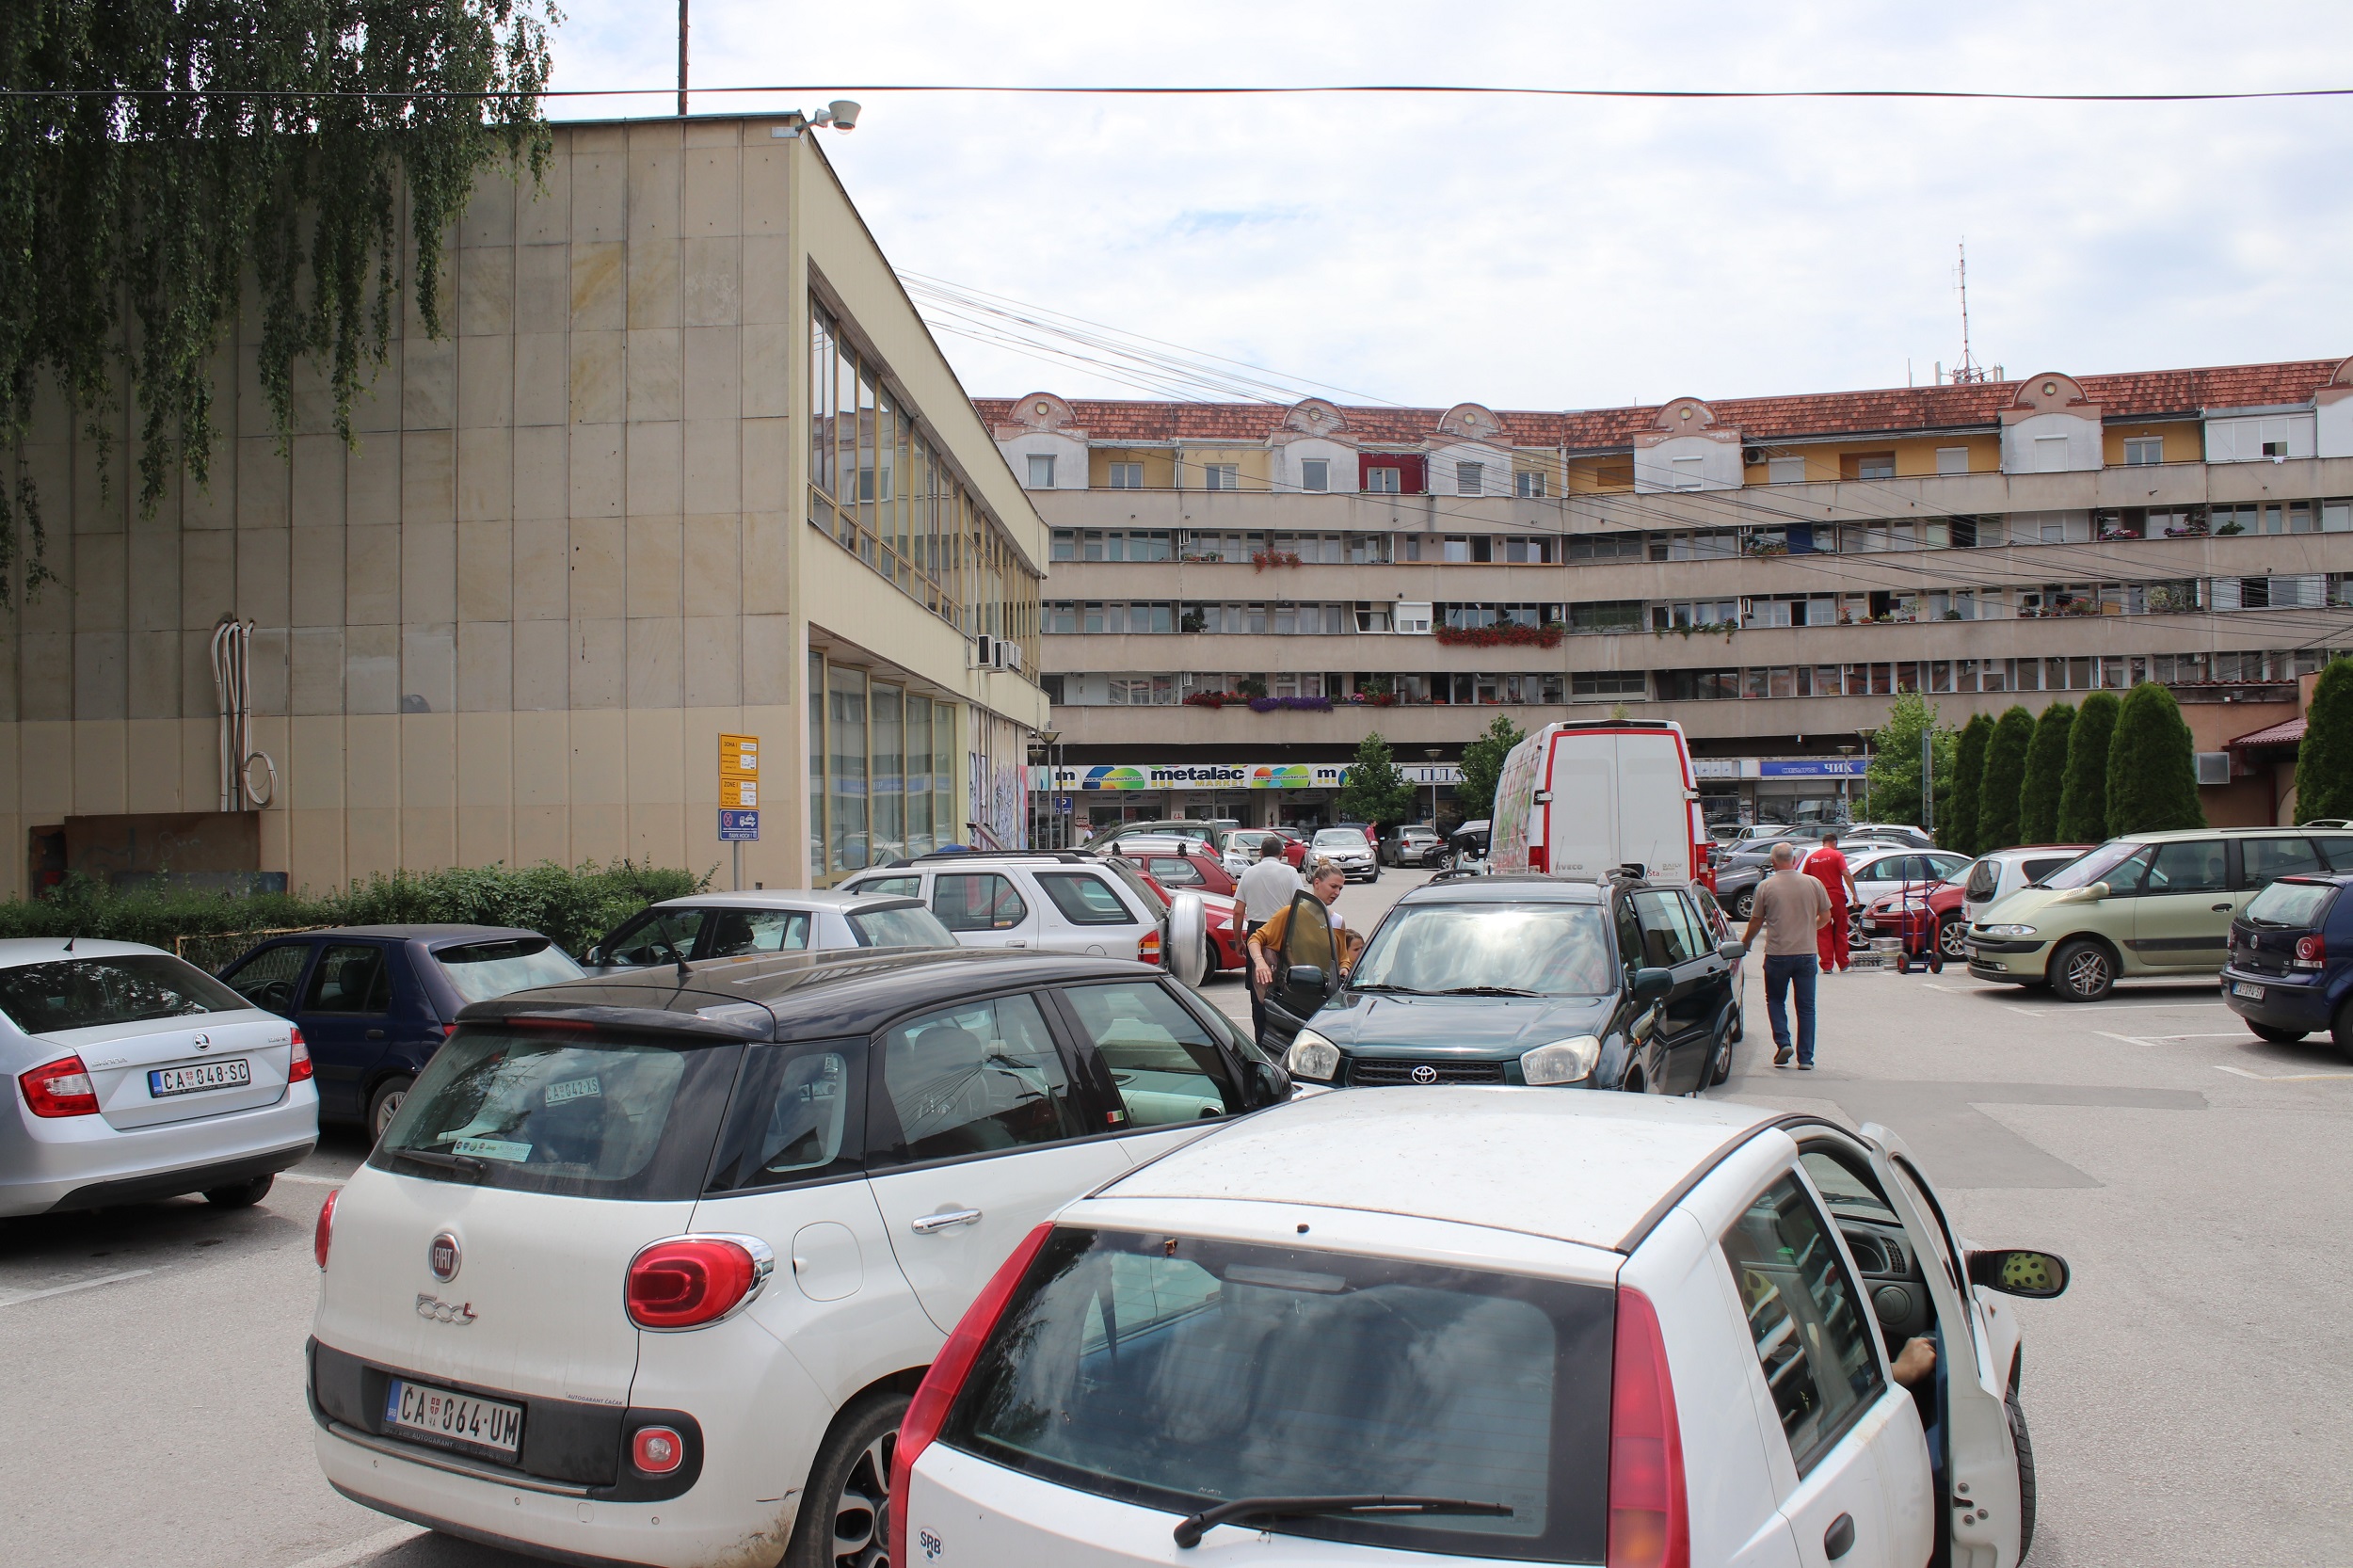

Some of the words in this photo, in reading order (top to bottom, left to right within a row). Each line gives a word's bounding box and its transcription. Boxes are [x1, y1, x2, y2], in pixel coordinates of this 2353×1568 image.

[1150, 766, 1245, 780] metalac
[1824, 763, 1854, 773] ЧИК
[164, 1071, 185, 1090] ČA
[434, 1247, 453, 1270] FIAT
[416, 1293, 479, 1326] 500L
[401, 1386, 425, 1425] ČA
[568, 1394, 603, 1403] AUTOGARANT
[387, 1407, 397, 1417] SRB
[411, 1432, 454, 1448] AUTOGARANT
[920, 1530, 941, 1555] SRB
